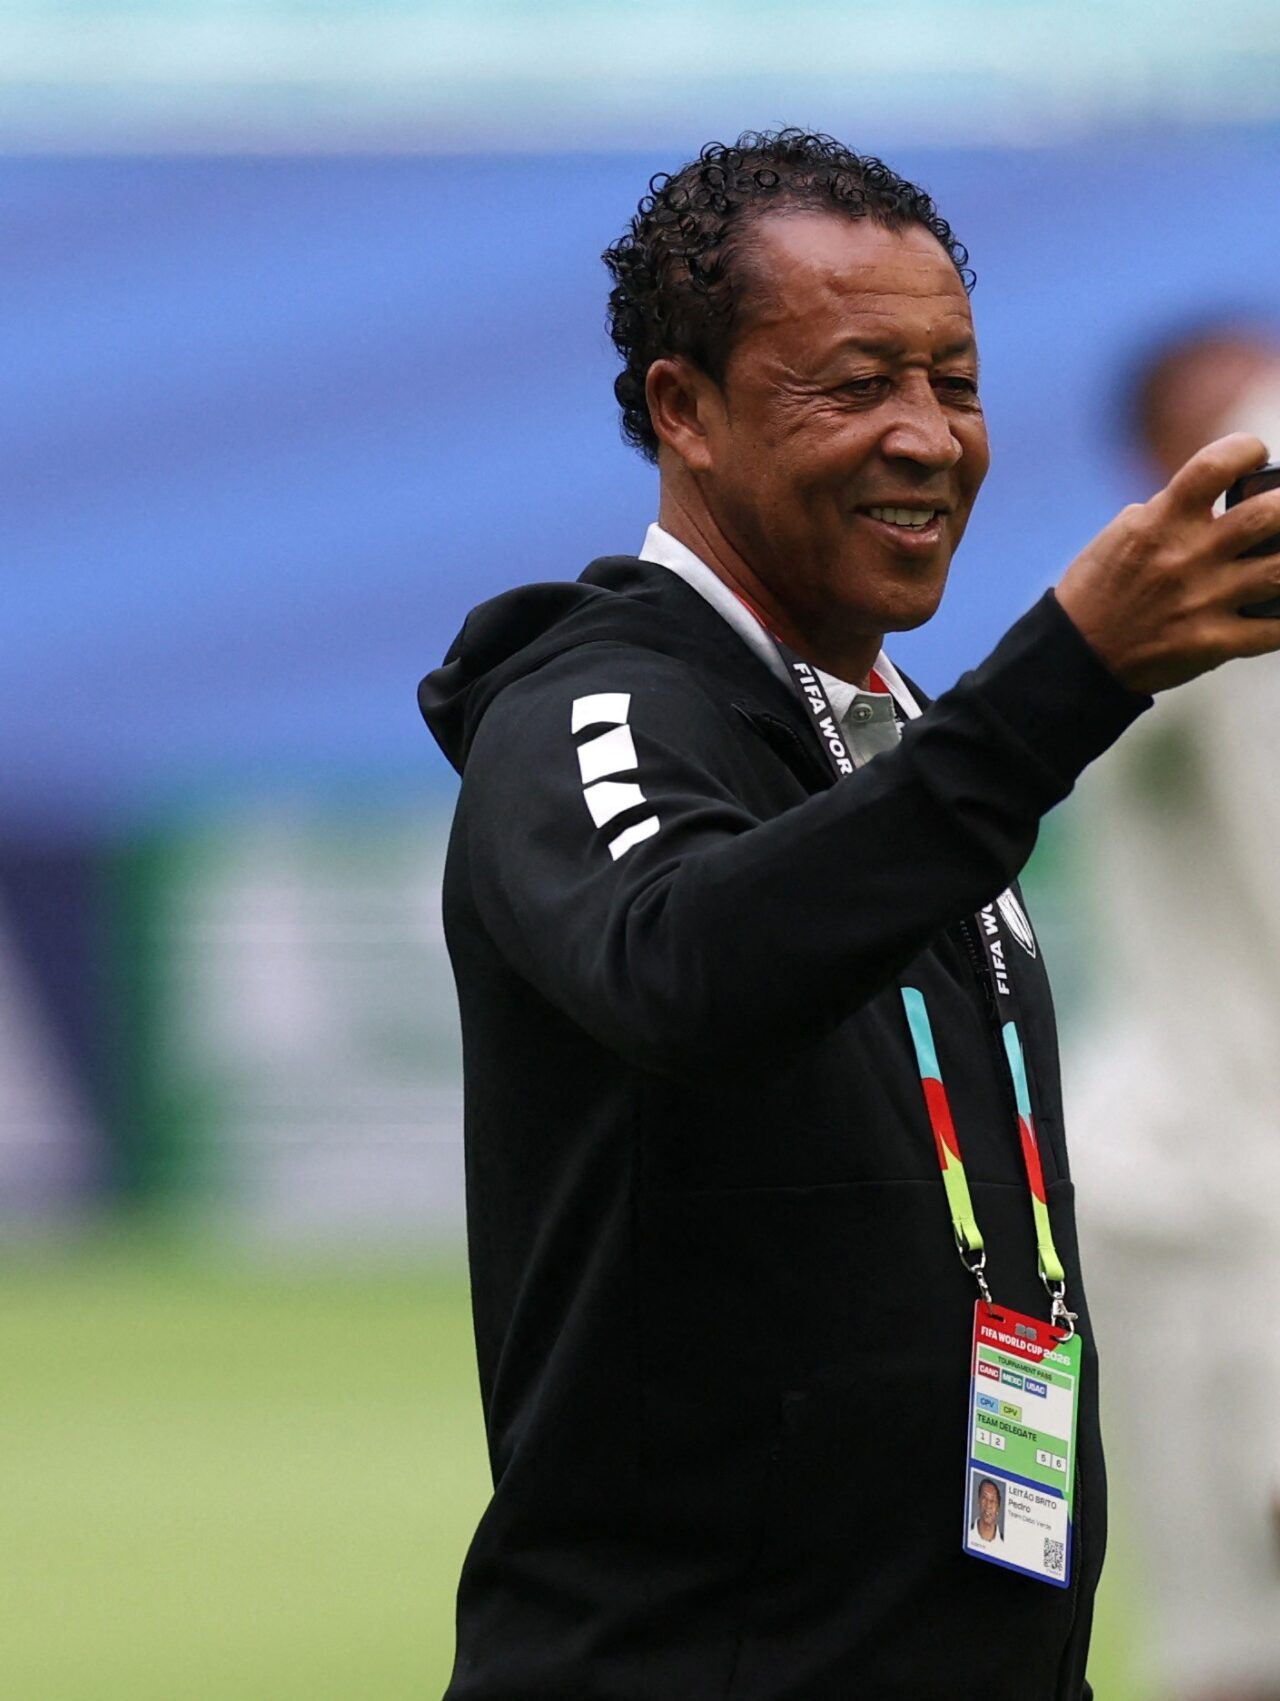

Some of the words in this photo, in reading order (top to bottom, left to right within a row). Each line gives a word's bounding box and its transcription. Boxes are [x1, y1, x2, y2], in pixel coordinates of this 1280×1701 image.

[793, 663, 827, 715] FIFA
[819, 716, 853, 776] WOR
[990, 940, 1010, 995] FIFA
[981, 1325, 998, 1341] FIFA
[999, 1332, 1026, 1351] WORLD
[1027, 1343, 1043, 1356] CUP
[1044, 1349, 1071, 1366] 2026
[998, 1356, 1037, 1376] TOURNAMENT
[1037, 1369, 1053, 1381] PASS
[980, 1398, 995, 1408] CPV
[1003, 1406, 1018, 1416] CPV
[977, 1413, 998, 1428] TEAM
[1000, 1422, 1037, 1442] DELEGATE
[995, 1438, 1001, 1446] 2
[1041, 1454, 1046, 1462] 5
[1056, 1459, 1062, 1468] 6
[1008, 1498, 1031, 1513] Pedro
[1035, 1495, 1057, 1510] BRITO
